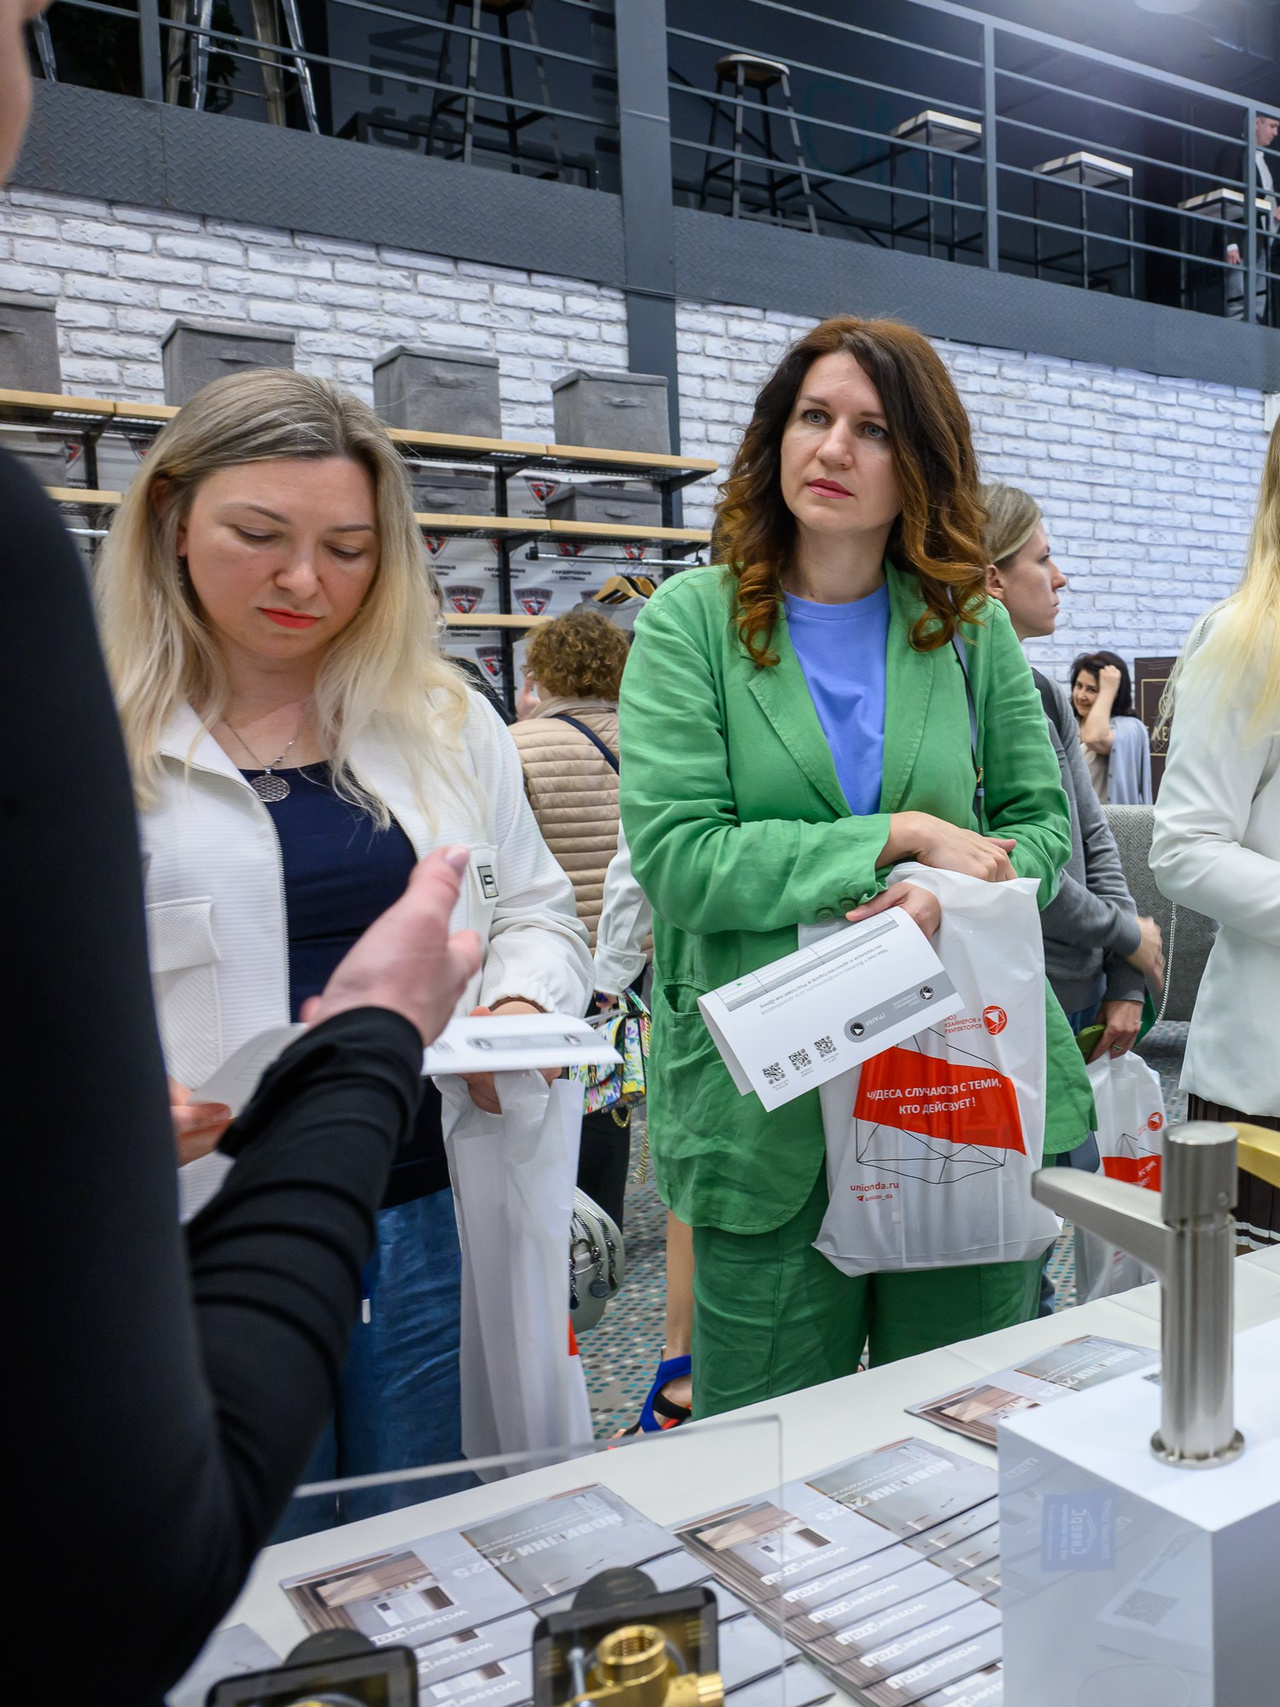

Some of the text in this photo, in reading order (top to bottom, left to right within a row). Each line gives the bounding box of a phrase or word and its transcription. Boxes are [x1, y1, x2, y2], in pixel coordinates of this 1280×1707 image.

[867, 1089, 902, 1100] ЧУДЕСА
[960, 1082, 967, 1092] С
[968, 1078, 1002, 1089] ТЕМИ,
[899, 1104, 920, 1114] КТО
[922, 1098, 971, 1115] ДЕЙСВУЕТ
[850, 1182, 899, 1192] unionda.ru
